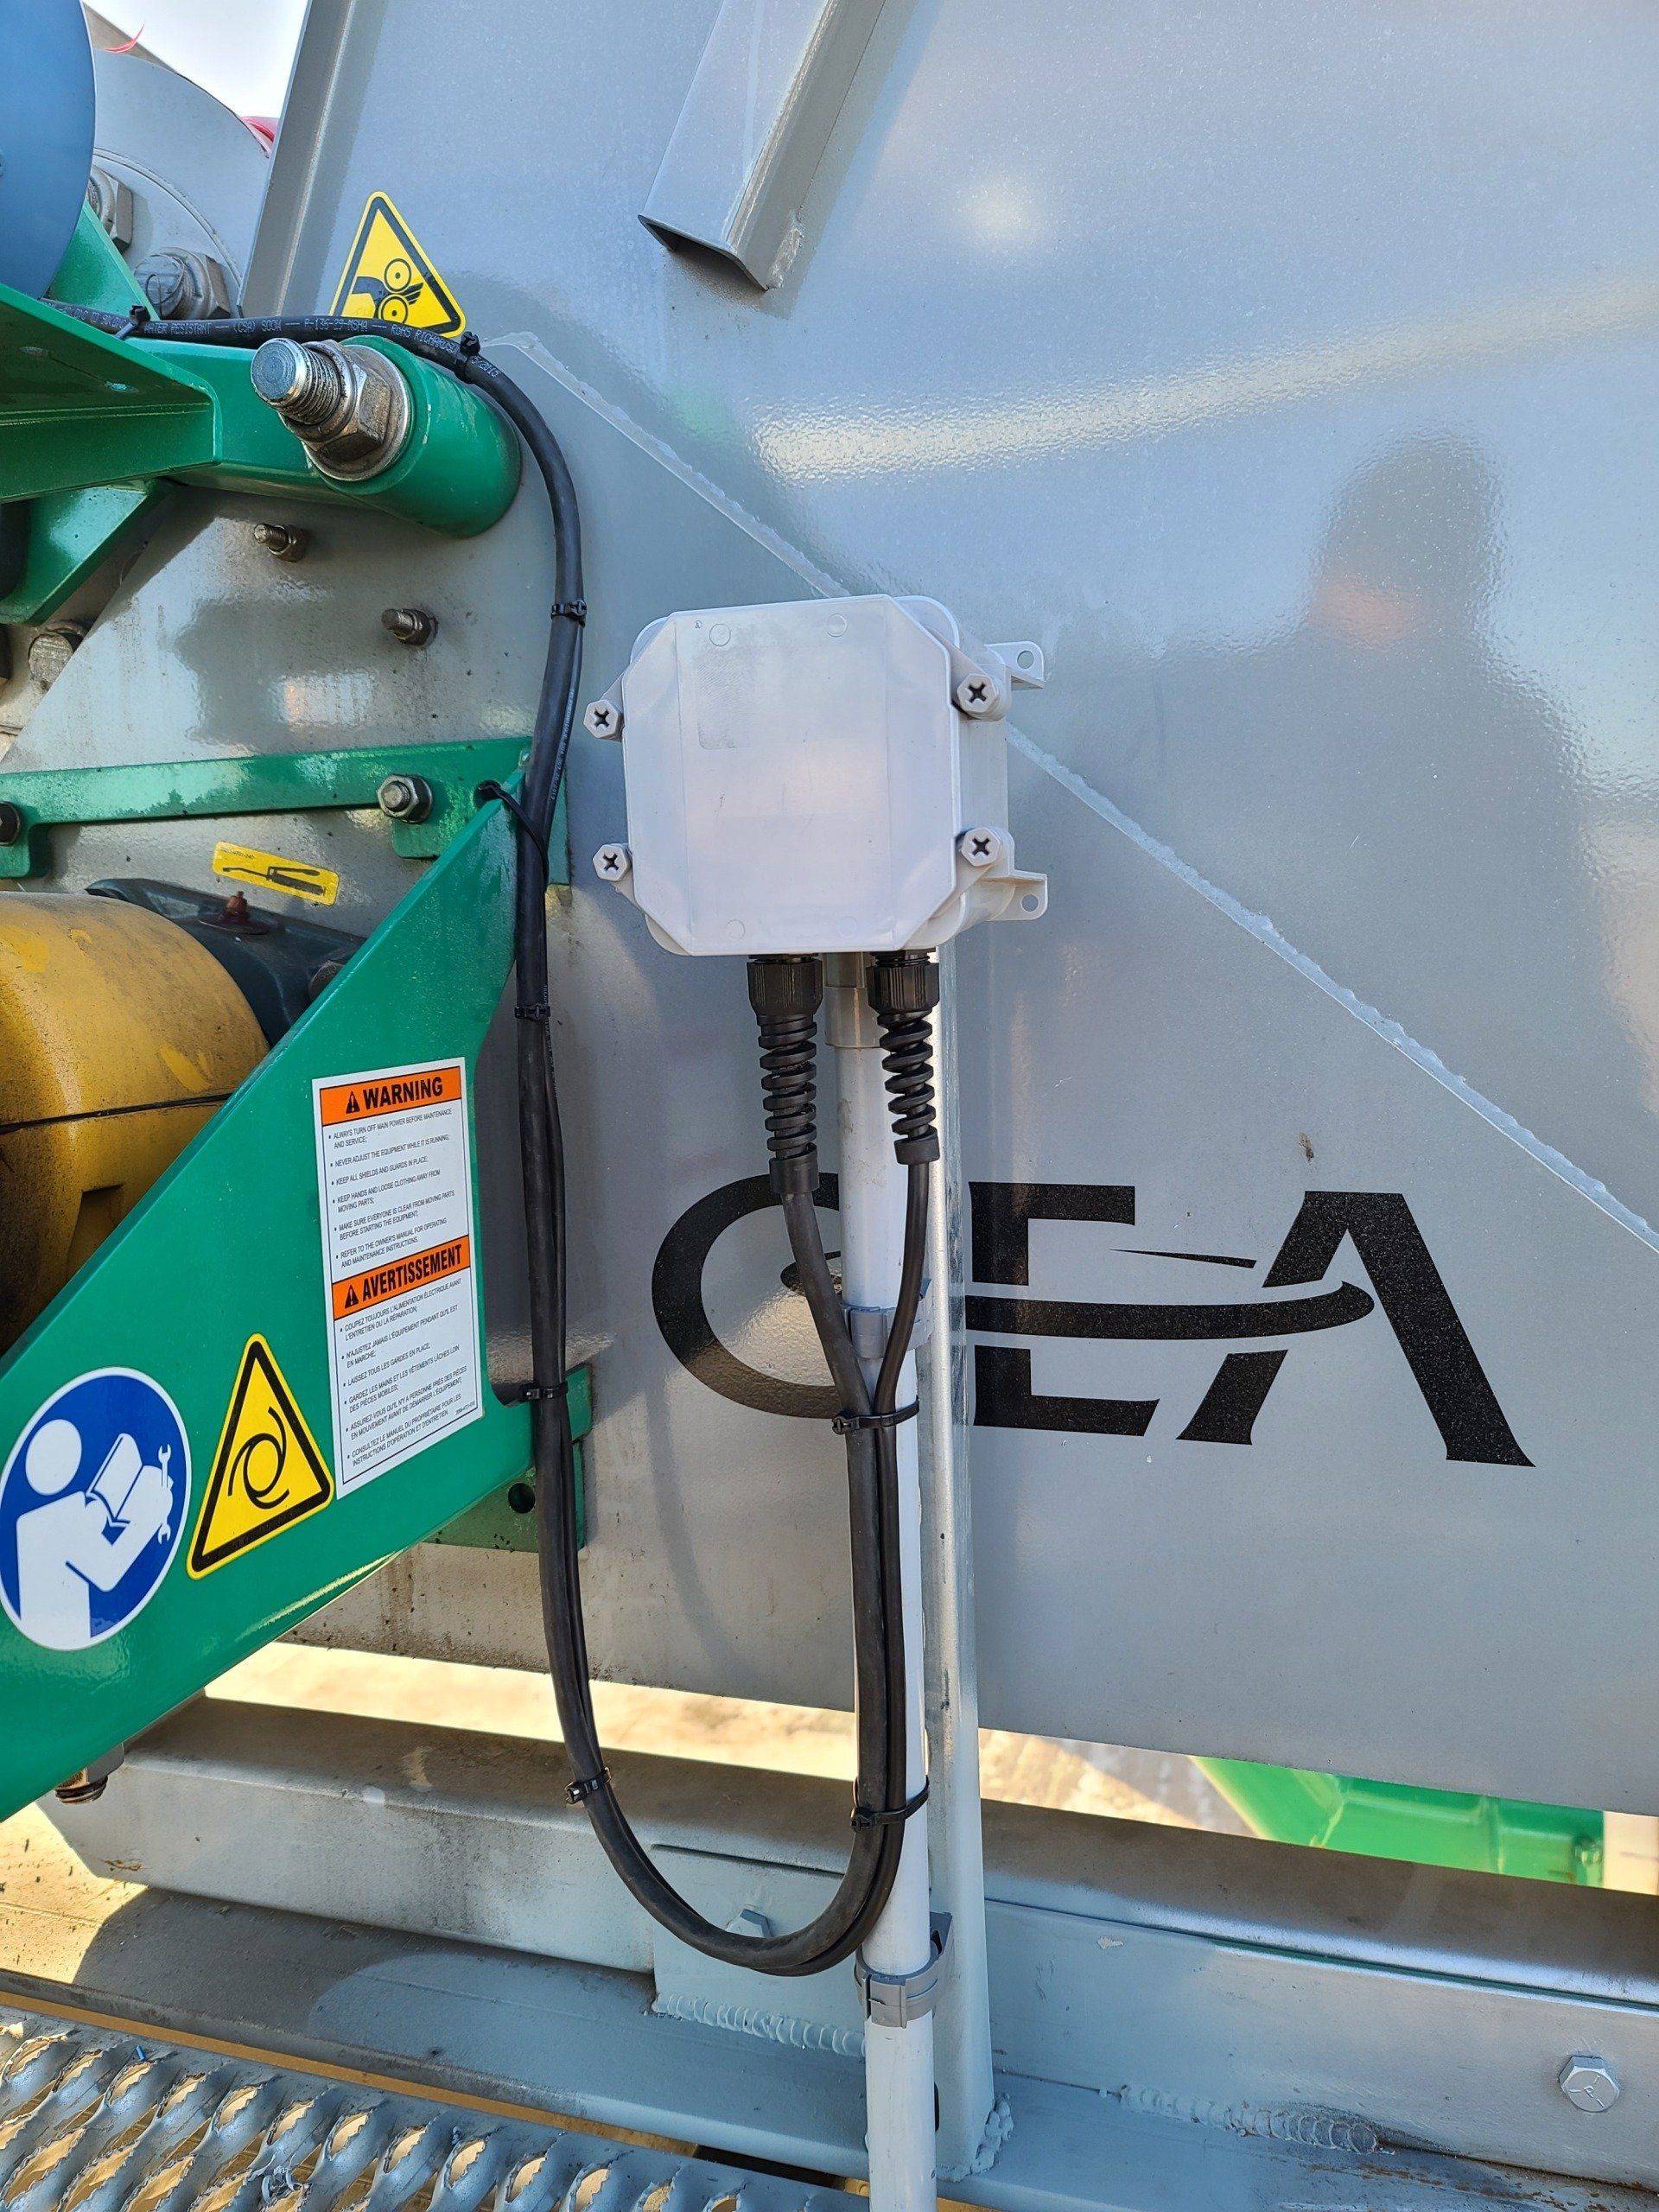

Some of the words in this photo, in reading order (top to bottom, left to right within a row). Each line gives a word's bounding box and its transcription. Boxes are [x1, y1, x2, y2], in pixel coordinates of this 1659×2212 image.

[363, 1077, 443, 1110] WARNING
[333, 1128, 353, 1139] ALWAYS
[353, 1126, 365, 1135] TURN
[389, 1118, 405, 1127] POWER
[406, 1115, 423, 1123] BEFORE
[423, 1109, 451, 1120] MAINTENANCE
[334, 1140, 344, 1148] AND
[334, 1156, 352, 1166] NEVER
[352, 1152, 370, 1163] ADJUST
[380, 1144, 406, 1156] EQUIPMENT
[406, 1141, 420, 1149] WHILE
[336, 1175, 349, 1185] KEEP
[349, 1173, 358, 1181] ALL
[359, 1168, 378, 1179] SHIELDS
[378, 1166, 388, 1174] AND
[389, 1160, 407, 1171] GUARDS
[337, 1193, 350, 1204] KEEP
[351, 1189, 367, 1199] HANDS
[367, 1186, 378, 1195] AND
[378, 1182, 393, 1192] LOOSE
[394, 1176, 416, 1187] CLOTHING
[416, 1173, 427, 1181] AWAY
[428, 1169, 440, 1178] FROM
[338, 1201, 357, 1213] MOVING
[339, 1220, 353, 1230] MAKE
[353, 1217, 365, 1226] SURE
[367, 1209, 391, 1222] EVERYONE
[397, 1203, 411, 1213] CLEAR
[412, 1198, 424, 1208] FROM
[425, 1193, 441, 1205] MOVING
[442, 1190, 454, 1199] PARTS
[340, 1228, 359, 1241] BEFORE
[359, 1221, 382, 1234] STARTING
[383, 1218, 391, 1227] THE
[340, 1247, 357, 1258] REFER
[365, 1241, 374, 1250] THE
[396, 1228, 413, 1240] MANUAL
[414, 1225, 423, 1234] FOR
[423, 1217, 447, 1230] OPERATING
[340, 1258, 351, 1268] AND
[352, 1247, 385, 1264] MAINTENANCE
[362, 1244, 461, 1301] AVERTISSEMENT
[345, 1318, 364, 1332] COUPEZ
[365, 1307, 389, 1323] TOUJOURS
[448, 1278, 461, 1288] AVANT
[372, 1334, 388, 1348] JAMAIS
[420, 1313, 439, 1326] PENDANT
[347, 1370, 367, 1386] LAISSEZ
[368, 1364, 380, 1376] TOUS
[390, 1351, 408, 1366] GARDES
[349, 1389, 367, 1403] GARDEZ
[369, 1383, 378, 1394] LES
[378, 1376, 391, 1389] MAINS
[399, 1369, 408, 1378] LES
[450, 1344, 459, 1354] LOIN
[349, 1402, 359, 1413] DES
[350, 1407, 385, 1430] ASSUREZ-VOUS
[409, 1383, 431, 1400] PERSONNE
[359, 1414, 387, 1435] MOUVEMENT
[388, 1408, 402, 1421] AVANT
[352, 1437, 378, 1458] CONSULTEZ
[386, 1423, 404, 1439] MANUEL
[442, 1397, 453, 1408] POUR
[353, 1443, 385, 1467] INSTRUCTIONS
